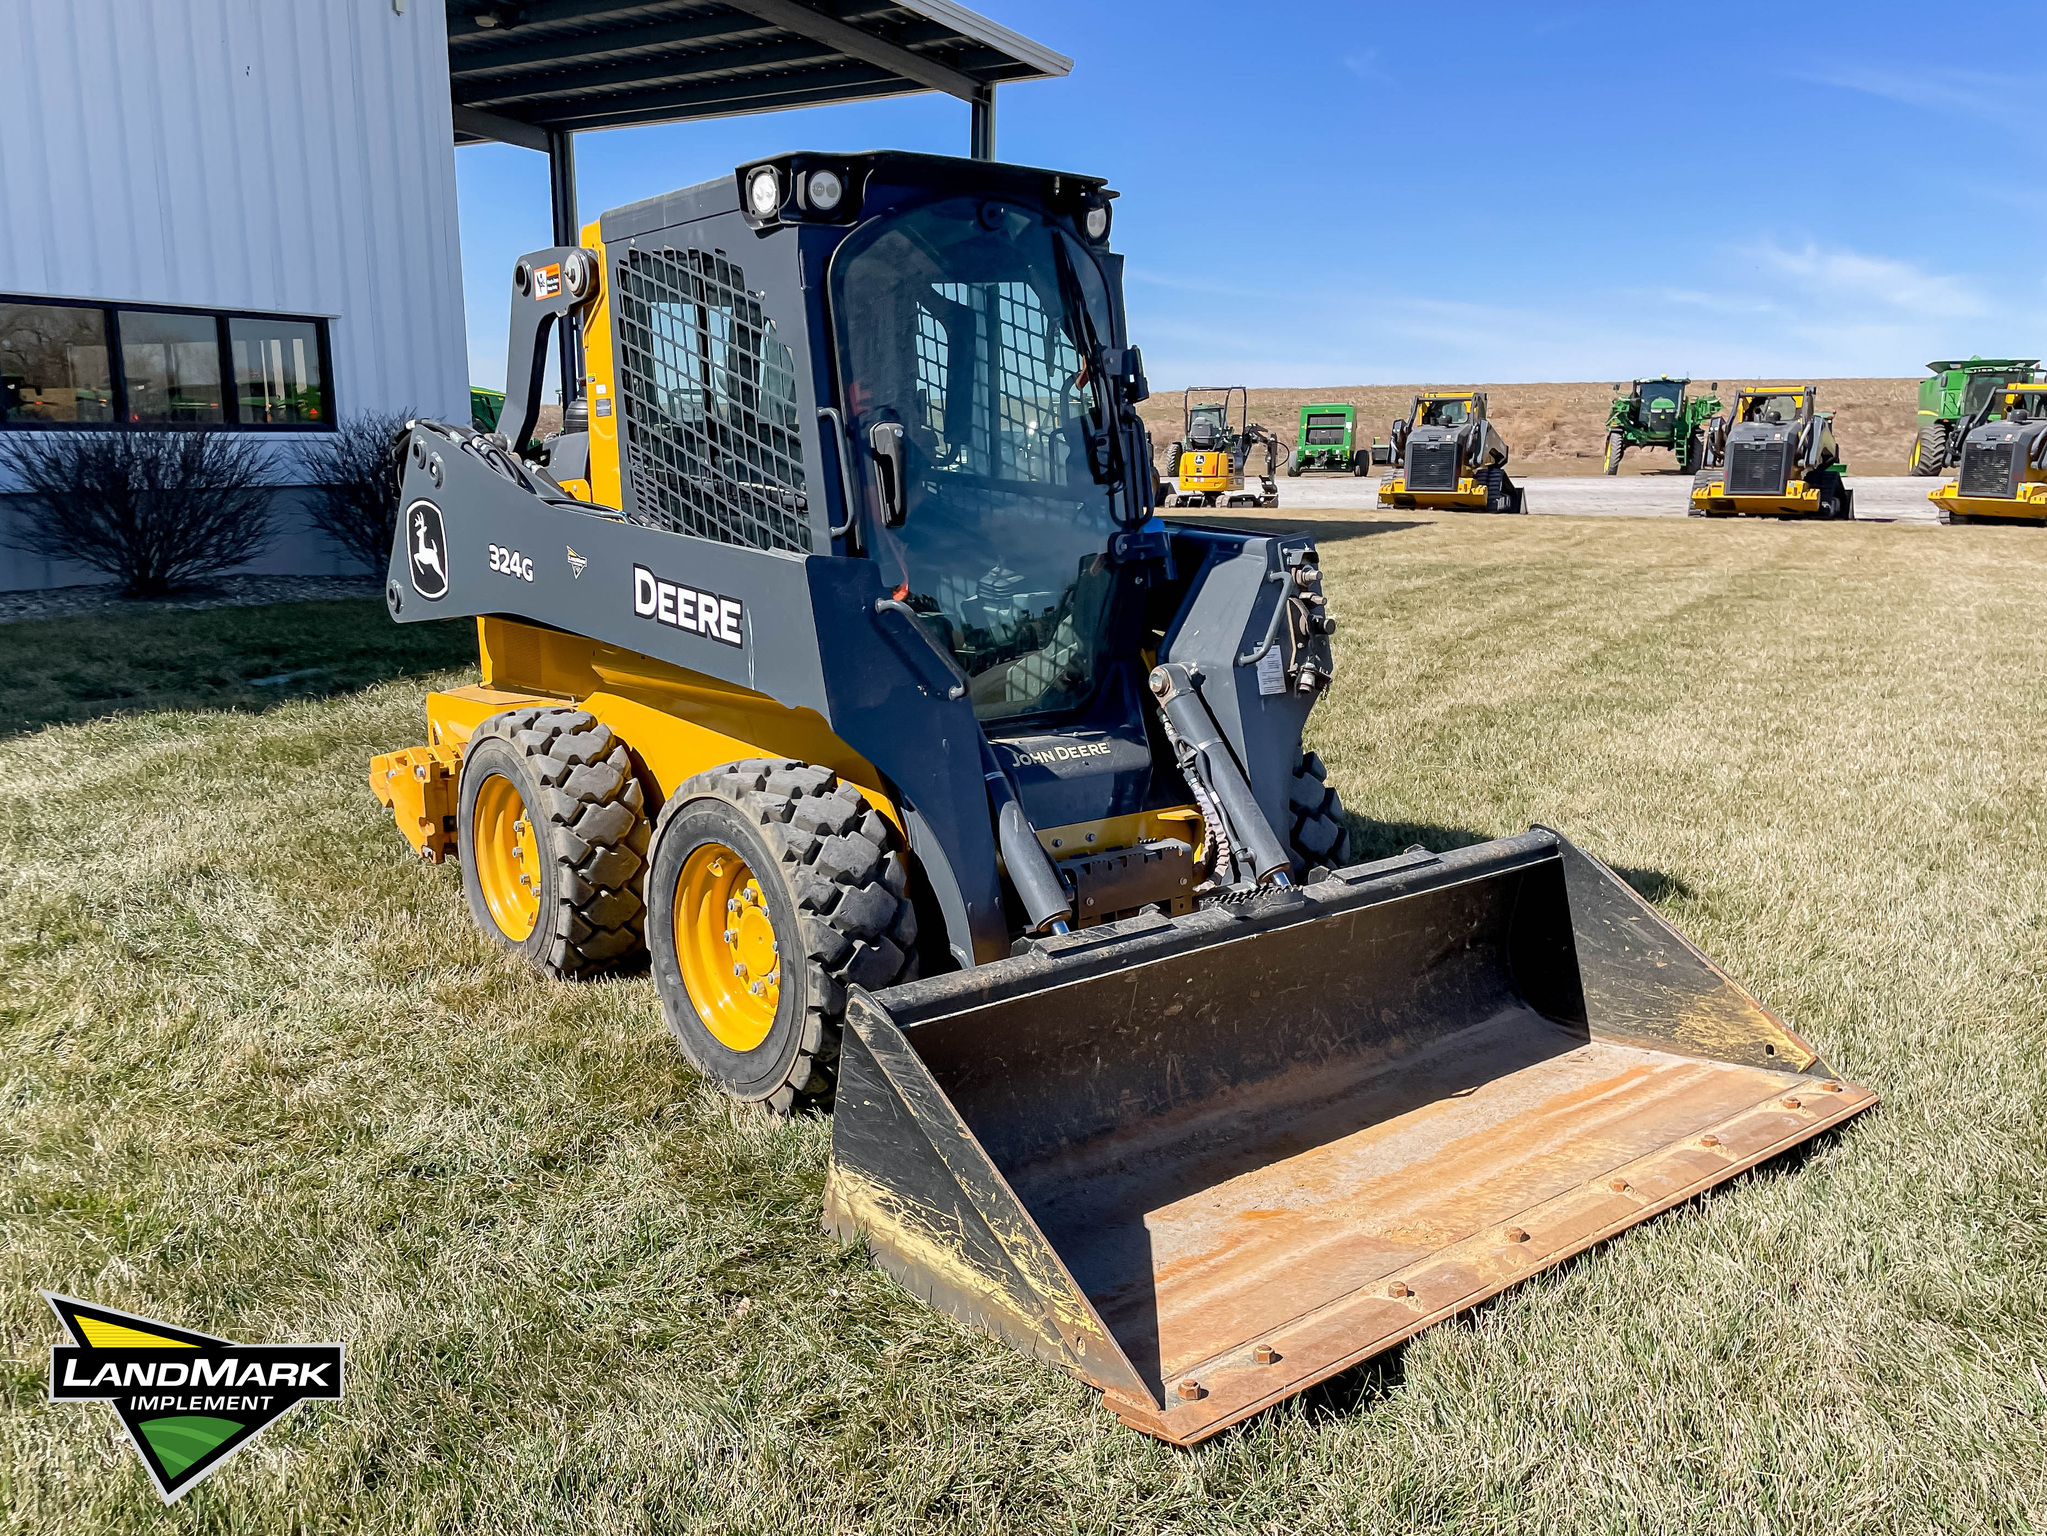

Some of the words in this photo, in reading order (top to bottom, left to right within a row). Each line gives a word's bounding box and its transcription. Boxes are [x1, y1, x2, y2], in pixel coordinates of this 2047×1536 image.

[488, 543, 534, 583] 324G
[633, 564, 743, 648] DEERE
[1012, 750, 1056, 767] JOHN
[1053, 742, 1111, 761] DEERE
